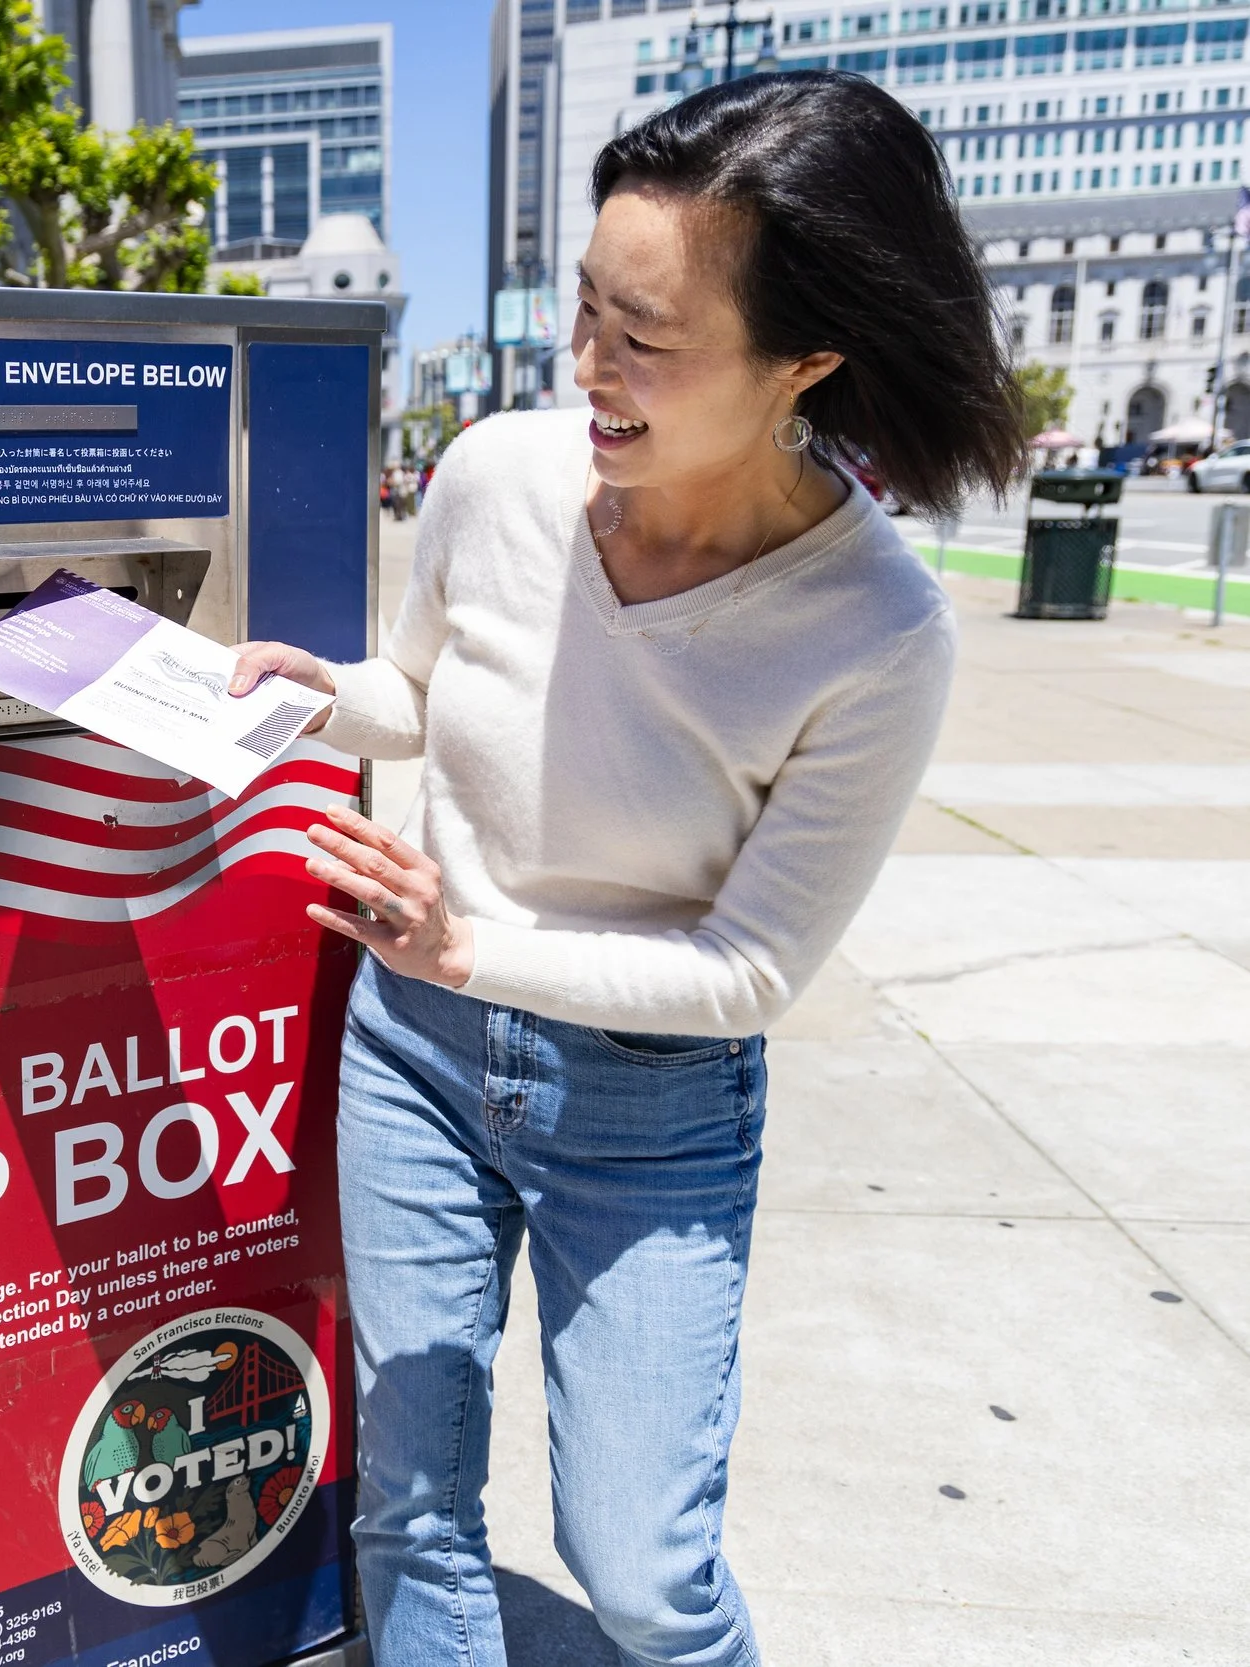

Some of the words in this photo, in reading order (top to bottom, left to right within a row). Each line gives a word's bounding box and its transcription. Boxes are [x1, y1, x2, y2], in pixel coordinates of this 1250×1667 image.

[6, 362, 135, 385] ENVELOPE
[143, 365, 226, 387] BELOW
[42, 479, 72, 488] 서명하신
[76, 479, 83, 488] 후
[86, 479, 109, 487] 아래에
[168, 494, 183, 502] KHE
[10, 615, 52, 638] Envelope
[16, 609, 45, 624] Ballot
[44, 621, 76, 641] Return
[113, 680, 158, 702] BUSINESS
[21, 1005, 298, 1115] BALLOT
[55, 1082, 296, 1226] BOX
[30, 1270, 61, 1290] For
[68, 1258, 110, 1283] your
[117, 1240, 167, 1266] ballot
[173, 1237, 190, 1252] to
[198, 1231, 218, 1246] be
[225, 1209, 298, 1238] counted,
[56, 1288, 91, 1308] Day
[98, 1271, 157, 1296] unless
[163, 1258, 207, 1278] there
[214, 1250, 240, 1266] are
[246, 1235, 299, 1257] voters
[70, 1312, 91, 1330] by
[98, 1308, 107, 1320] a
[114, 1291, 160, 1316] court
[166, 1280, 216, 1302] order.
[133, 1339, 155, 1360] San
[156, 1316, 212, 1345] Francisco
[214, 1312, 264, 1330] Elections
[188, 1395, 206, 1436] I
[95, 1424, 296, 1517] VOTED!
[276, 1484, 310, 1535] Bumoto
[308, 1455, 322, 1483] ako!
[67, 1530, 82, 1549] ¡Ya
[77, 1548, 102, 1576] voté!
[6, 1601, 62, 1630] 325-9163
